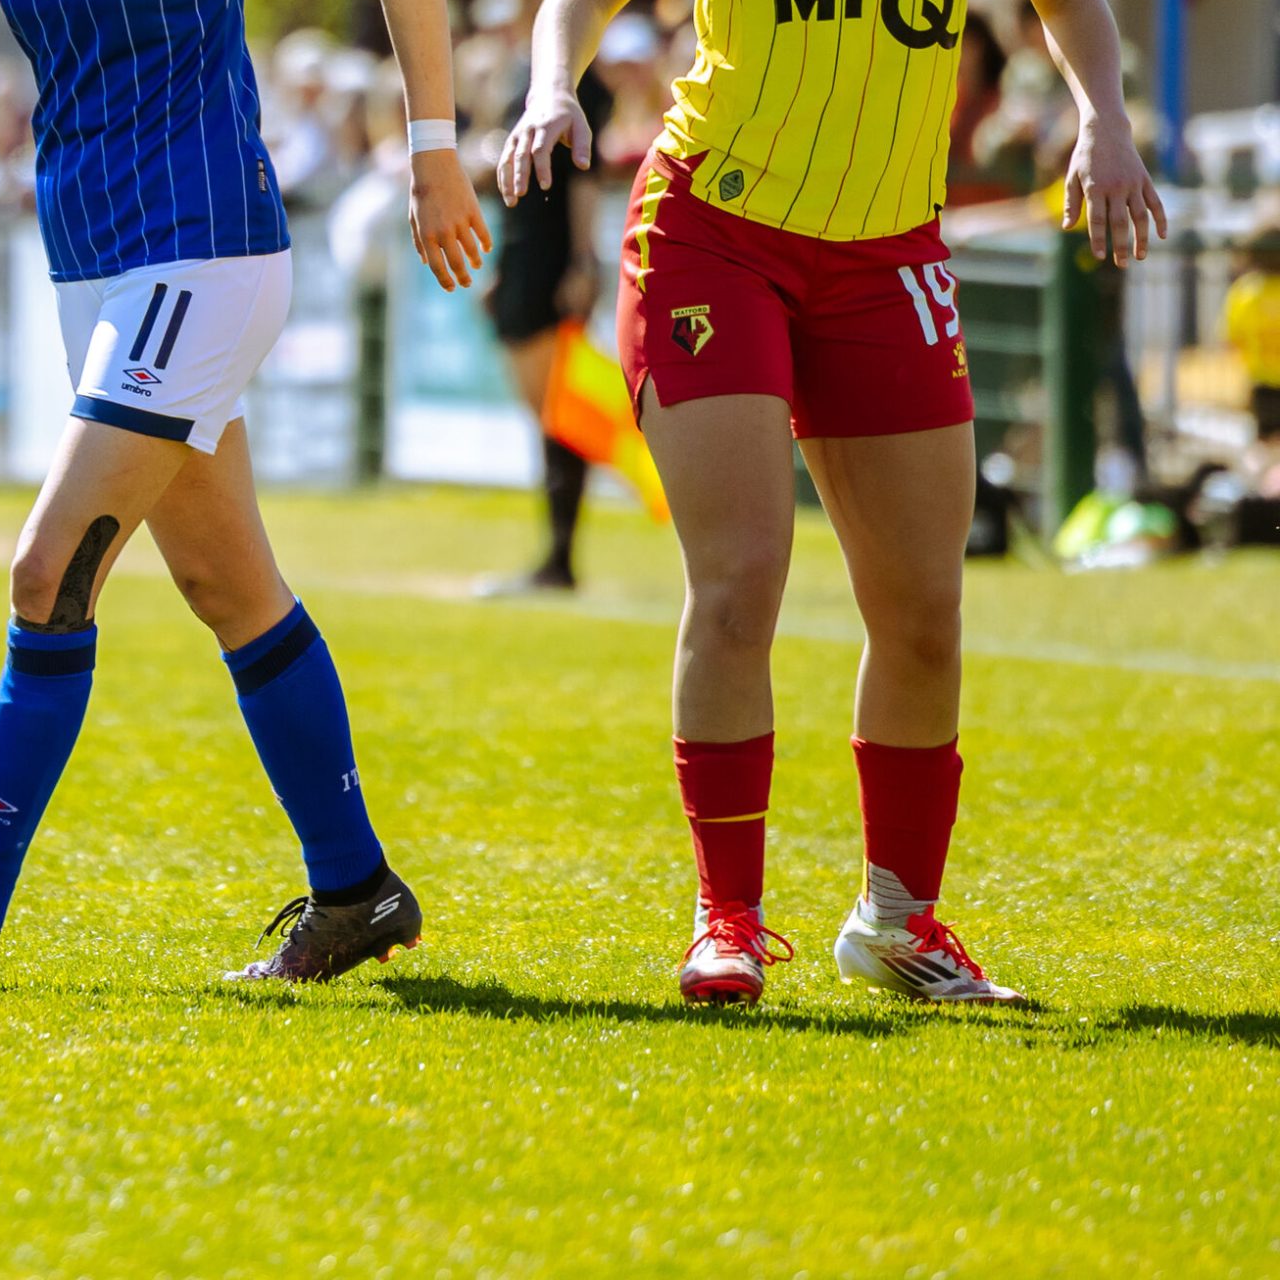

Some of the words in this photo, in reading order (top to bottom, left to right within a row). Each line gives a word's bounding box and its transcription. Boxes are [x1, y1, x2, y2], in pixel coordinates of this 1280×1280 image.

[128, 282, 193, 370] 11
[674, 306, 708, 316] WATFORD
[897, 260, 960, 347] 19
[121, 382, 152, 398] umbro
